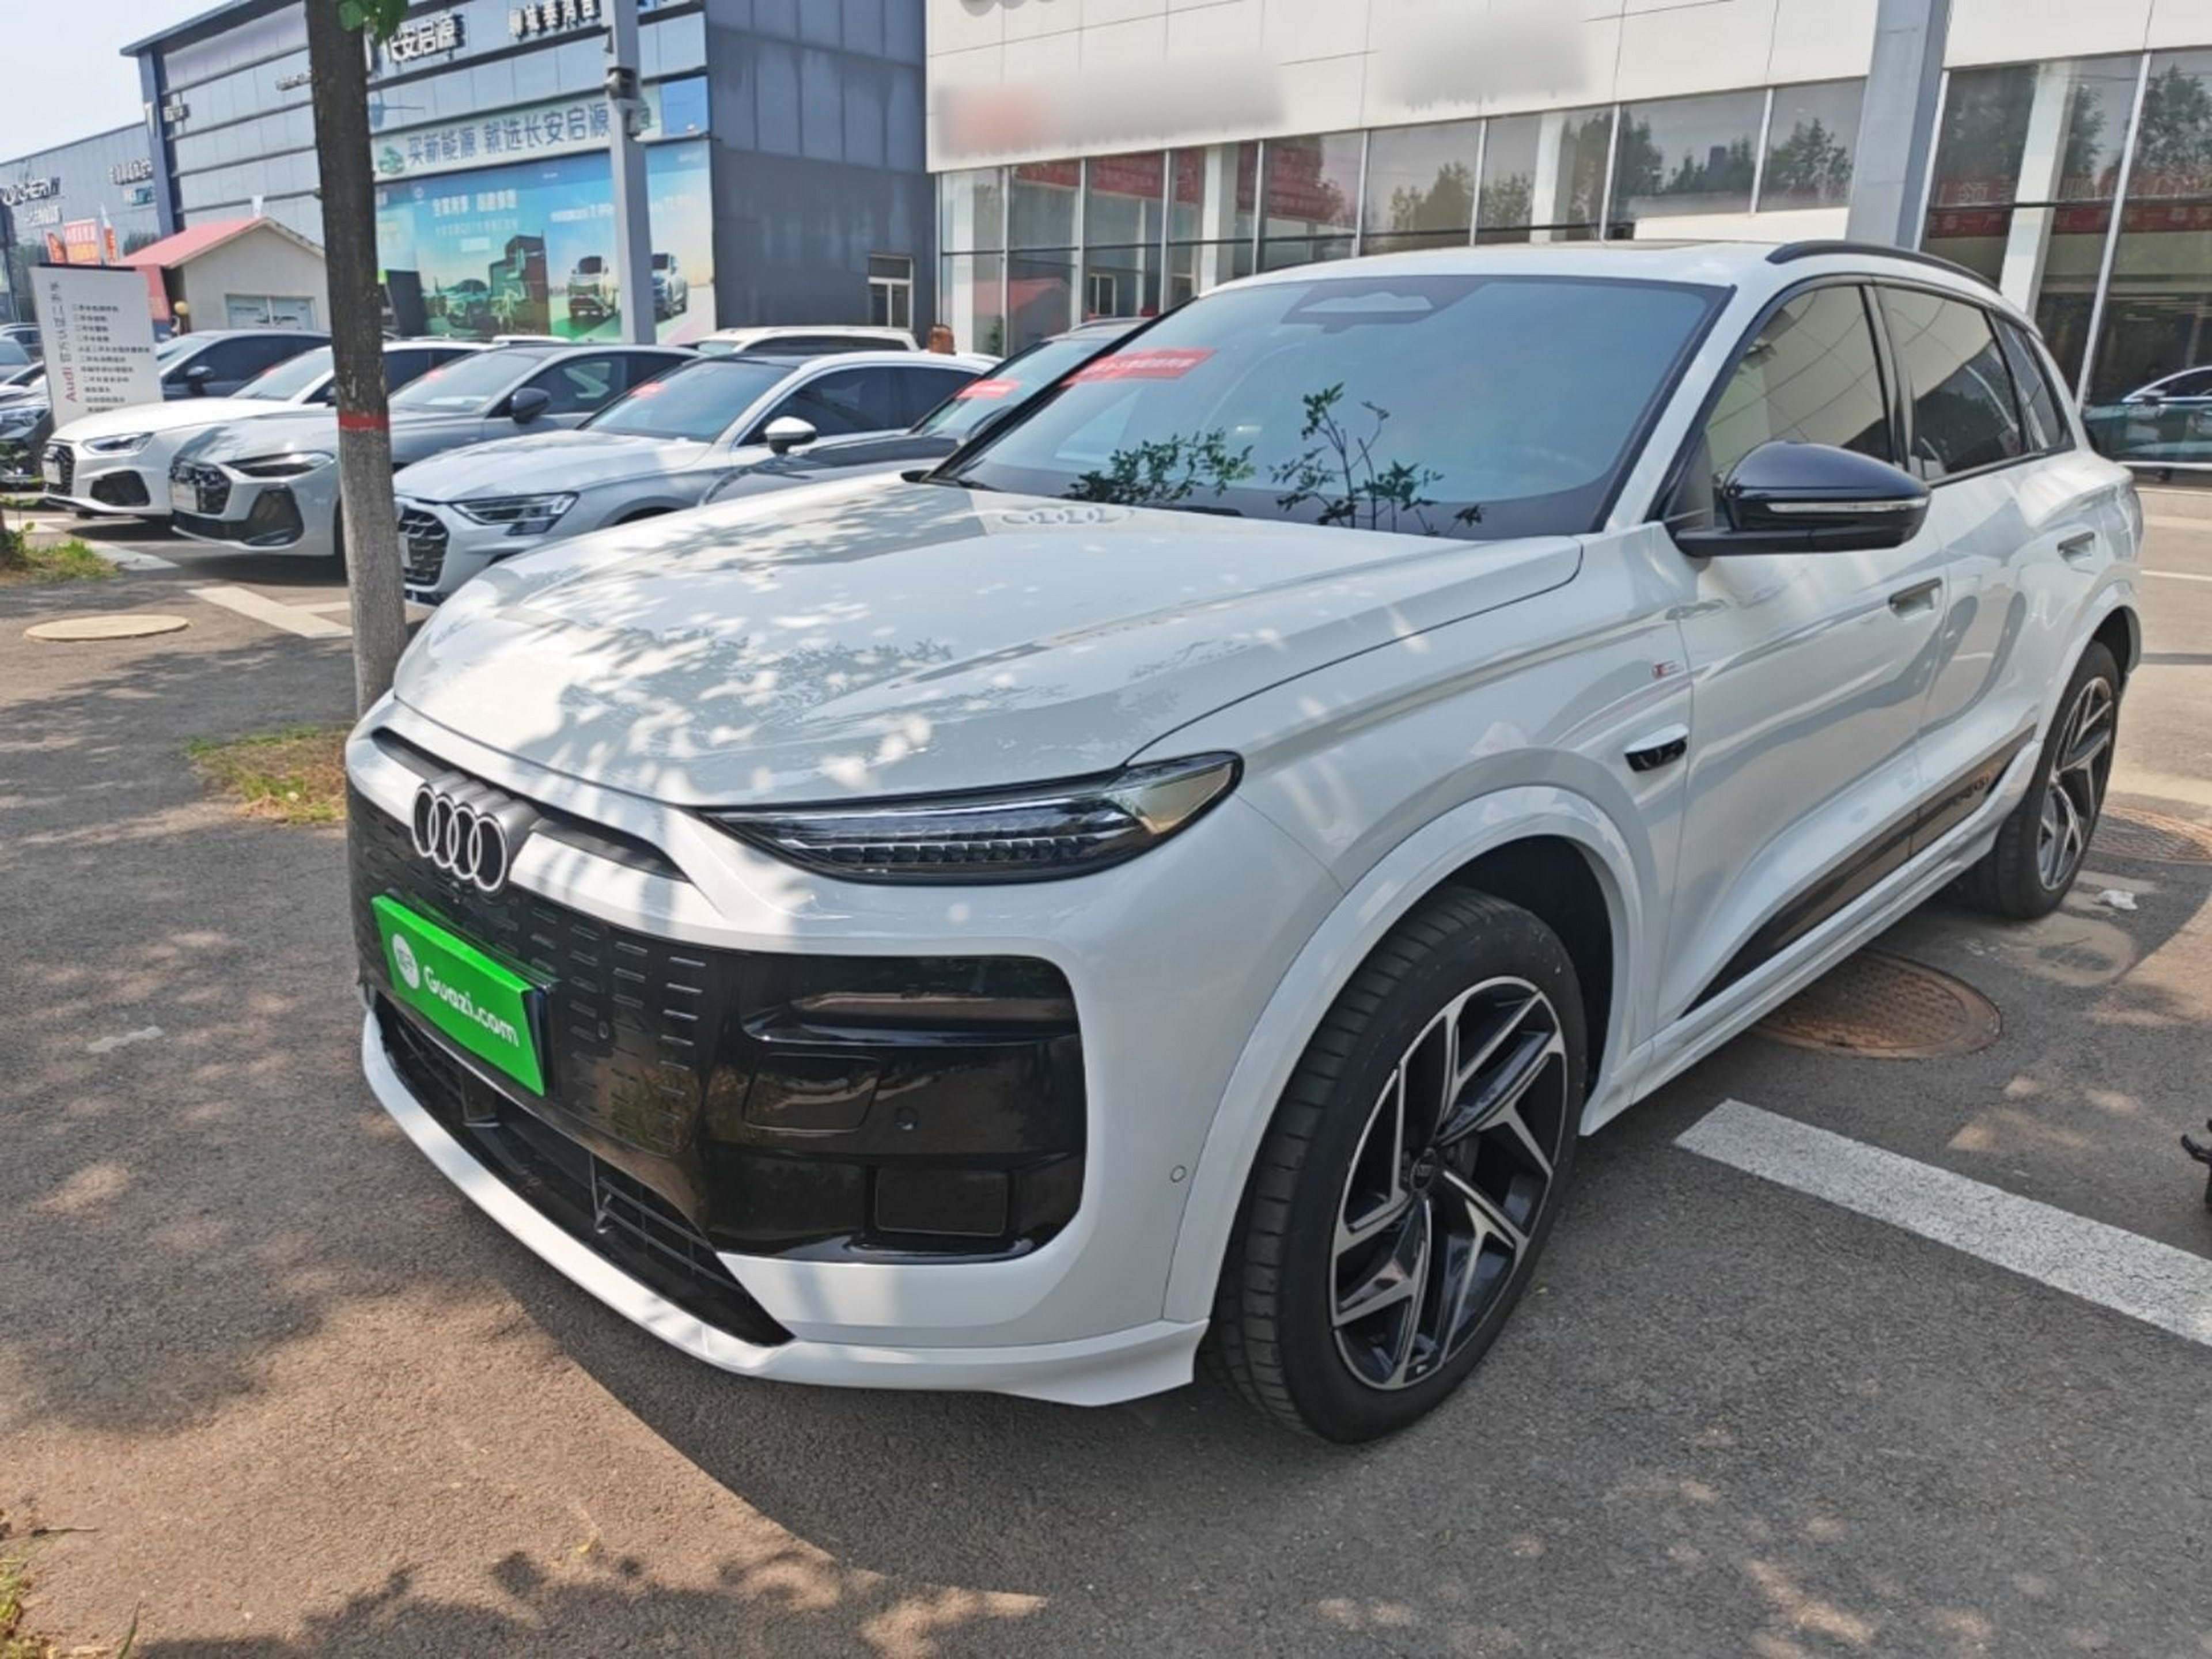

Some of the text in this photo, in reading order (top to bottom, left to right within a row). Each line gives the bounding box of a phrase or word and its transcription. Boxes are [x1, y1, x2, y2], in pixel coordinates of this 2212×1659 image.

[407, 103, 611, 165] 买新能源 就选长安启源
[62, 366, 77, 403] Audi
[423, 964, 519, 1048] Guazi.com
